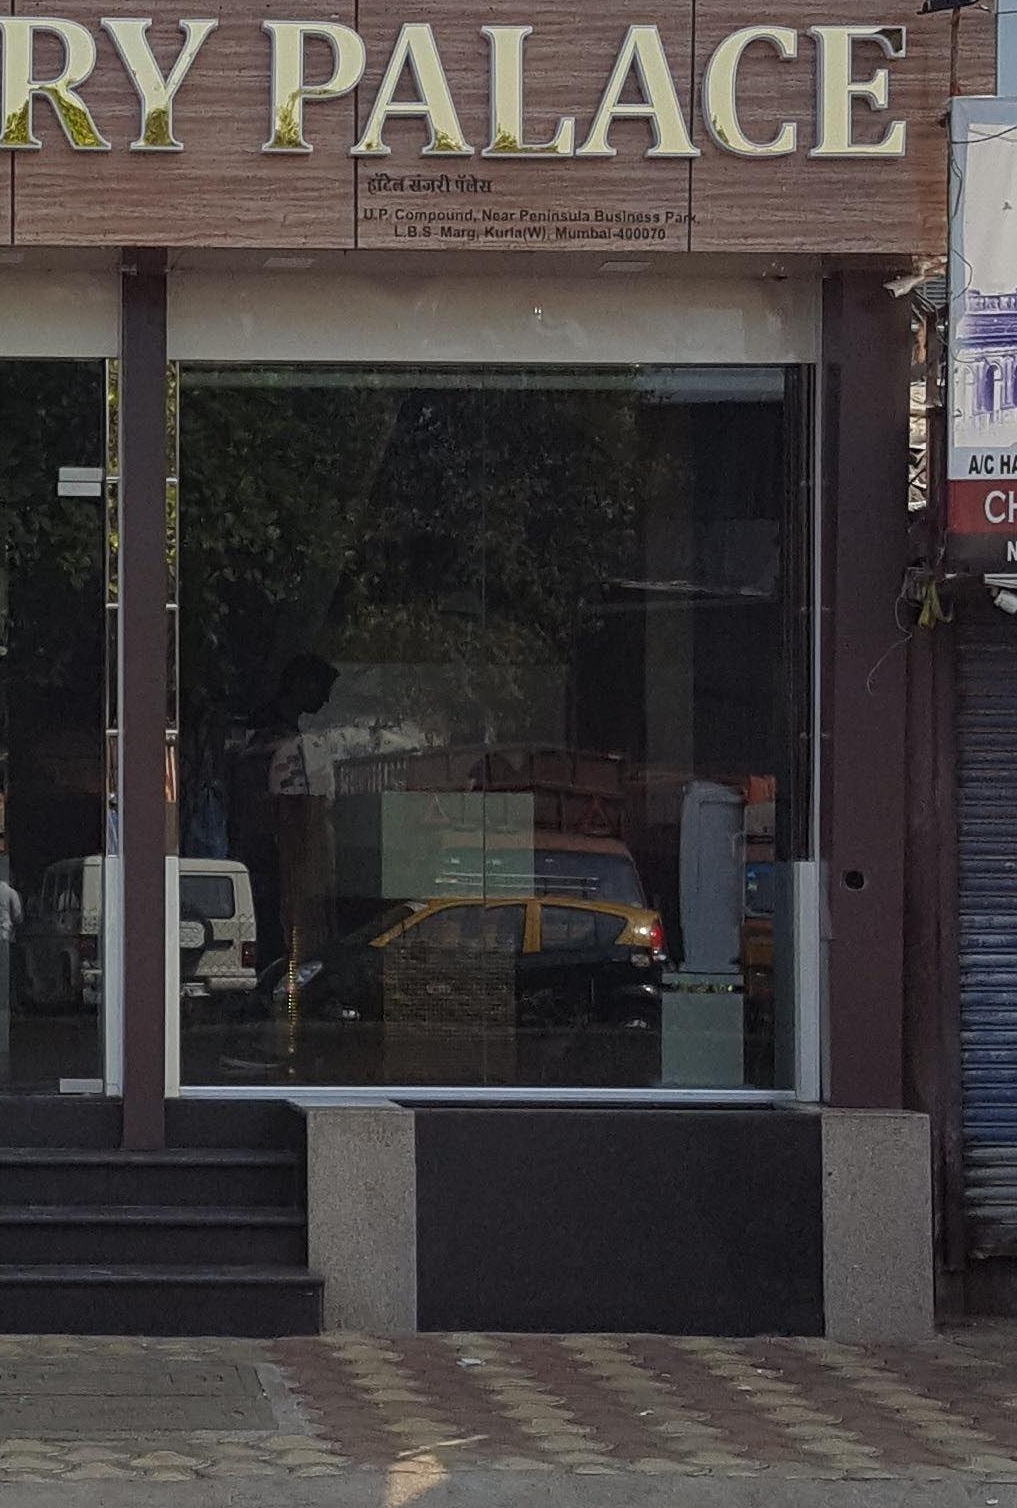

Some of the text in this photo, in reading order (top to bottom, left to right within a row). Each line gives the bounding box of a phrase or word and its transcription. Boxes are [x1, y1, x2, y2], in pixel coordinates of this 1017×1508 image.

[262, 19, 907, 158] PALACE
[395, 208, 477, 224] Compound,
[482, 208, 515, 222] Near
[519, 209, 590, 223] Peninsula
[594, 210, 660, 223] Business
[968, 454, 994, 475] A/C
